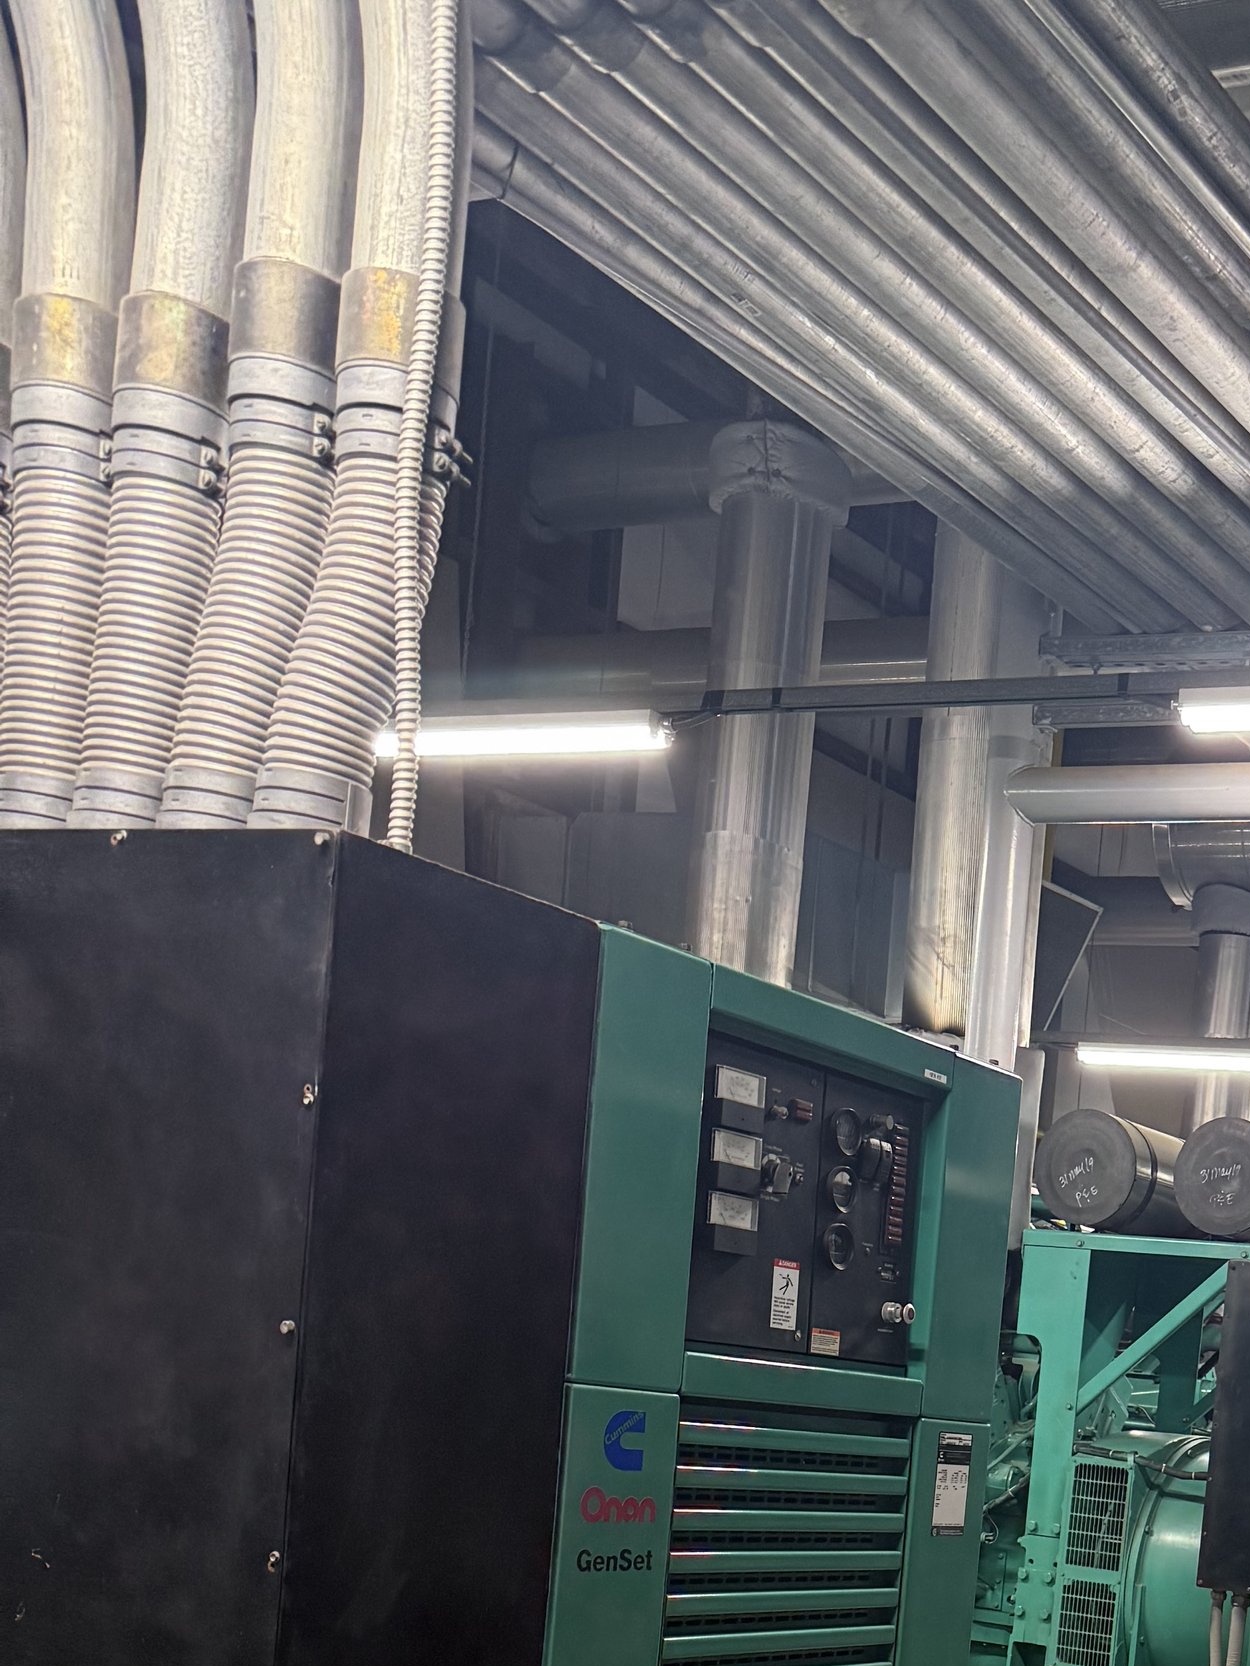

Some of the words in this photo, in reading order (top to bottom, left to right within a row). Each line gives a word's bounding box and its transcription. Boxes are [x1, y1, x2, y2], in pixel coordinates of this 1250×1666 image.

[604, 1411, 644, 1445] Cummins
[580, 1486, 656, 1523] Onan
[577, 1549, 652, 1572] GenSet
